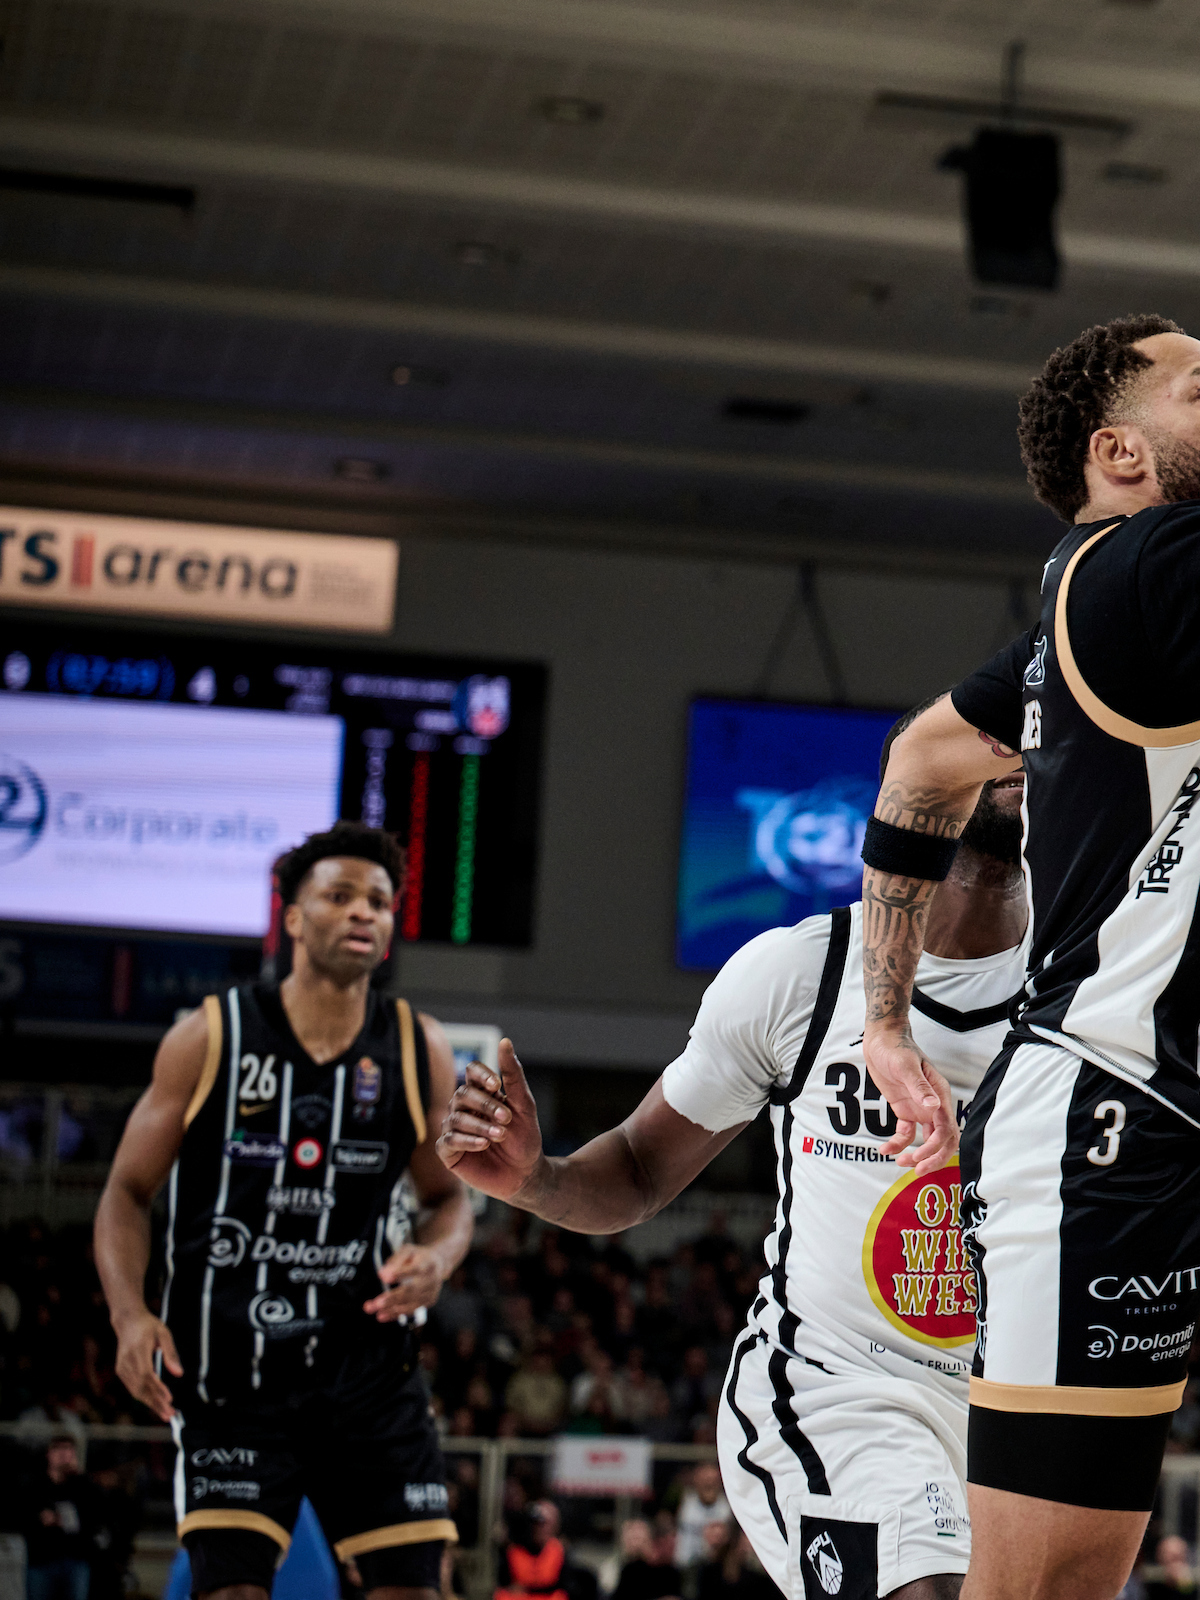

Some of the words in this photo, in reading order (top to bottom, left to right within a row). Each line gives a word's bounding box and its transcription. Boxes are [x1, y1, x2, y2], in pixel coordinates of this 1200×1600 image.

[103, 543, 299, 600] arena
[240, 1053, 277, 1101] 26
[1086, 1099, 1127, 1166] 3
[251, 1235, 369, 1266] Dolomiti
[891, 1273, 978, 1316] WES
[1124, 1303, 1178, 1315] TRENTO
[1121, 1321, 1196, 1352] Dolomiti
[1150, 1340, 1192, 1362] energia
[191, 1447, 259, 1468] CAVIT
[934, 1517, 967, 1534] GIUL
[806, 1531, 831, 1563] APU
